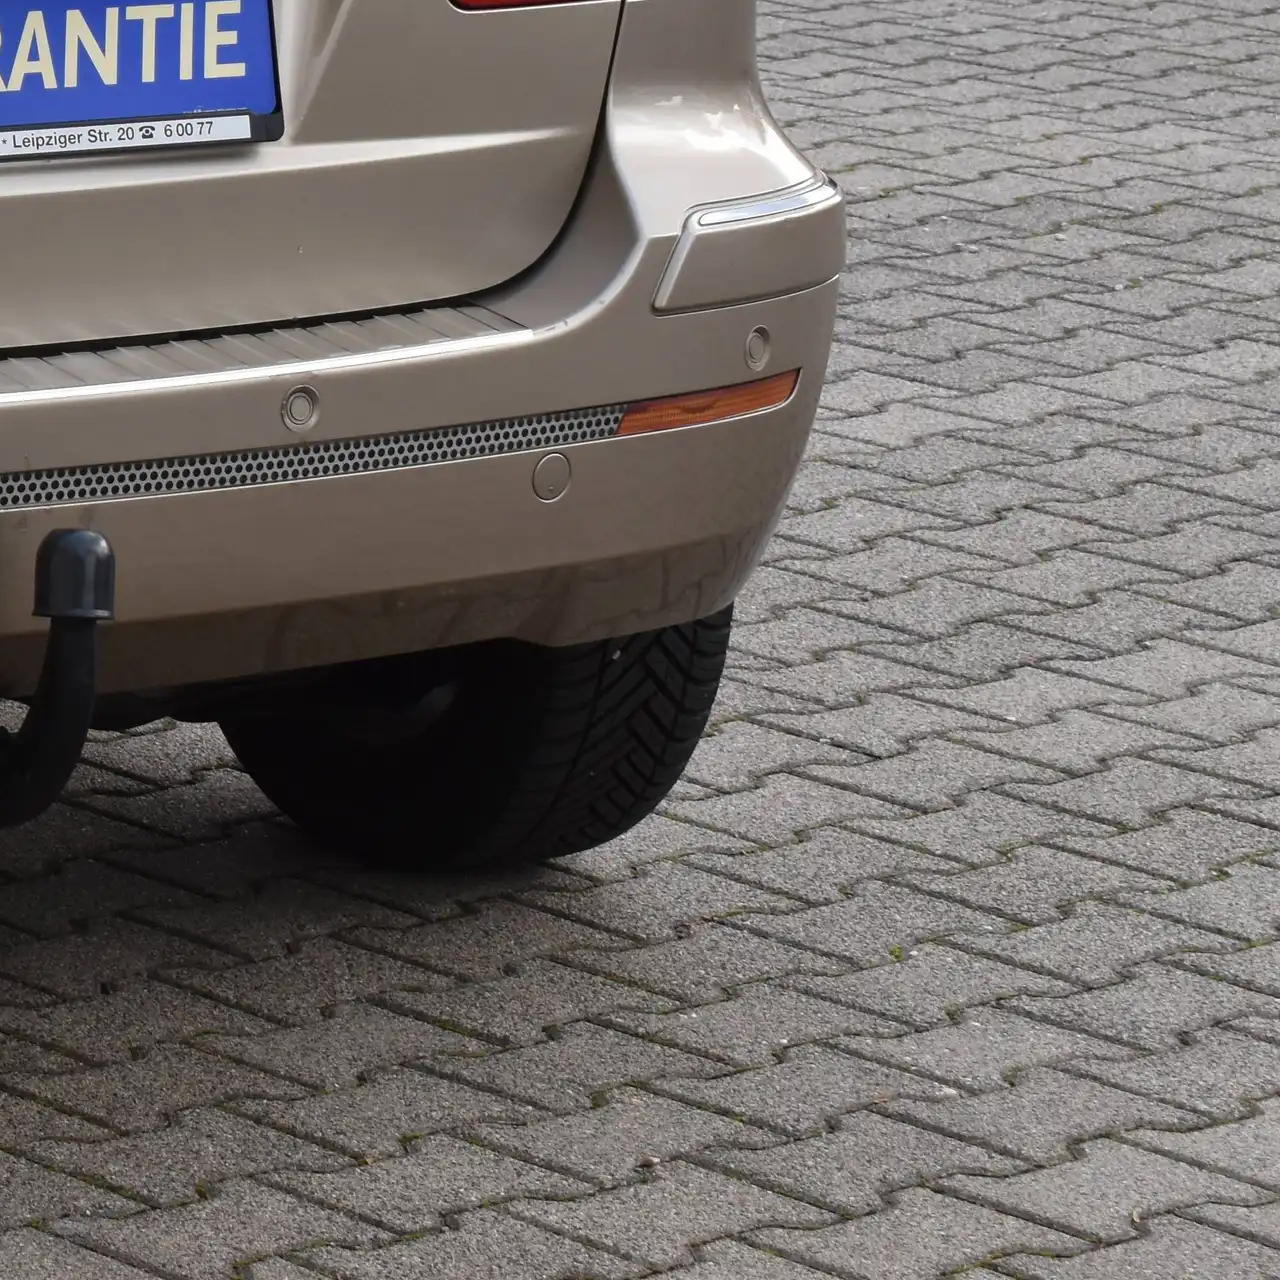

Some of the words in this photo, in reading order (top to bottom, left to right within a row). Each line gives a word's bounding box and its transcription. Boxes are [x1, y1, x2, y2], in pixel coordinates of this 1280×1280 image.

[12, 133, 83, 150] Leipziger
[87, 128, 113, 143] Str.
[117, 126, 135, 141] 20
